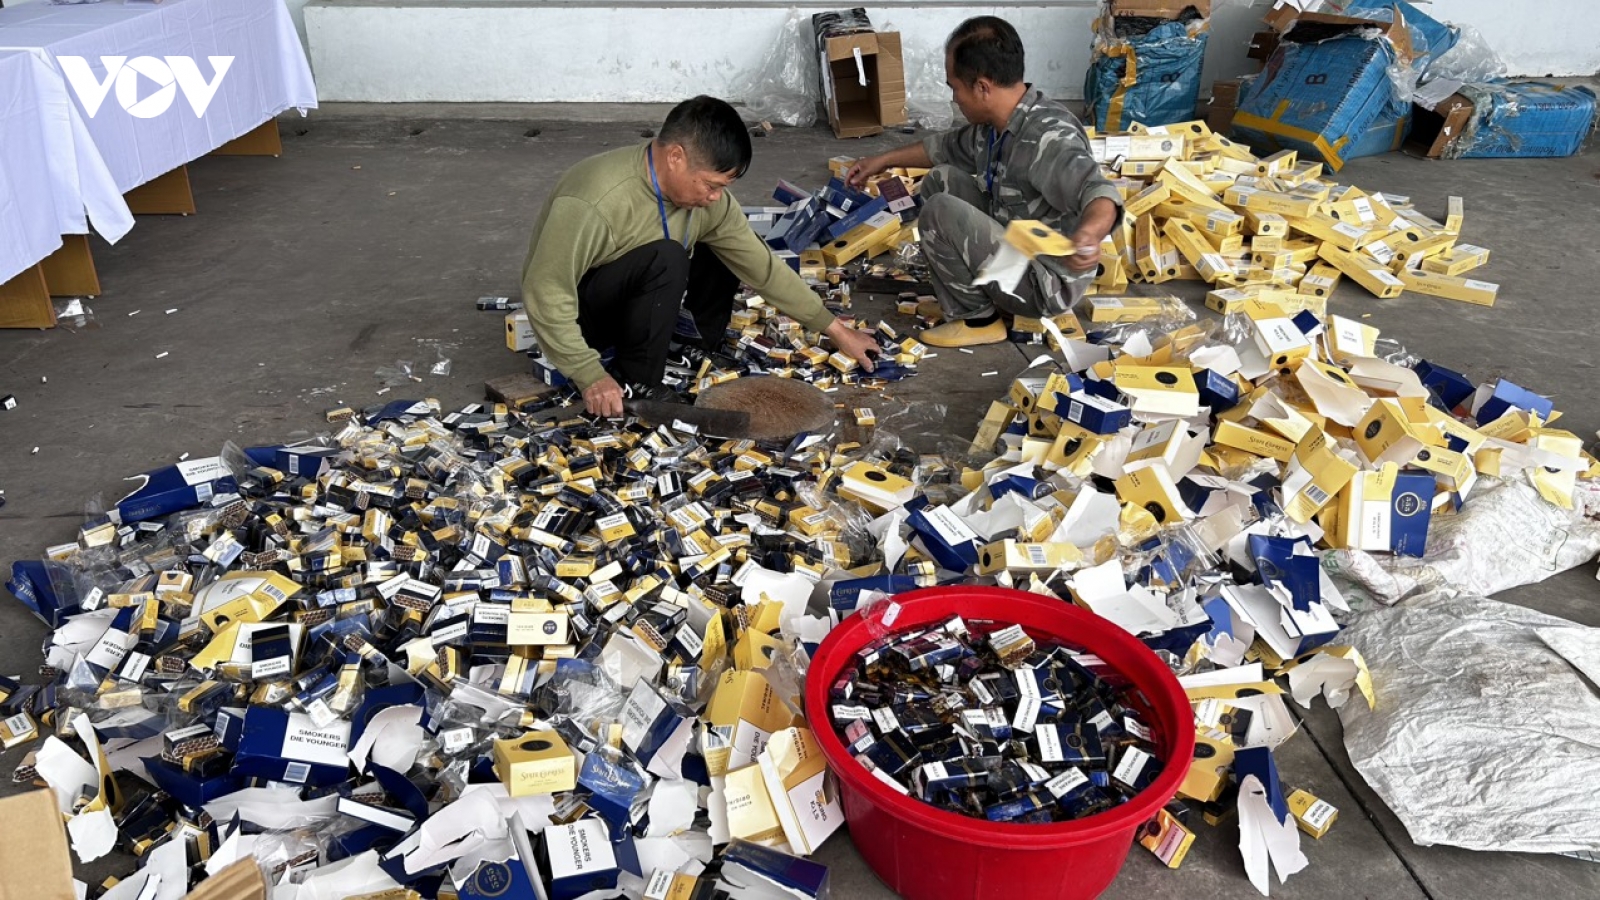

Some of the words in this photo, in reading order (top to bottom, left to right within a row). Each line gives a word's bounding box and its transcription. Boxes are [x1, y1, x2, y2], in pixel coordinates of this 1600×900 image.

[1264, 440, 1288, 452] EXPRESS
[298, 729, 341, 740] SMOKERS
[305, 737, 347, 748] YOUNGER
[568, 824, 576, 836] DIE
[578, 829, 592, 862] SMOKERS
[570, 835, 583, 870] YOUNGER
[485, 866, 500, 889] 555
